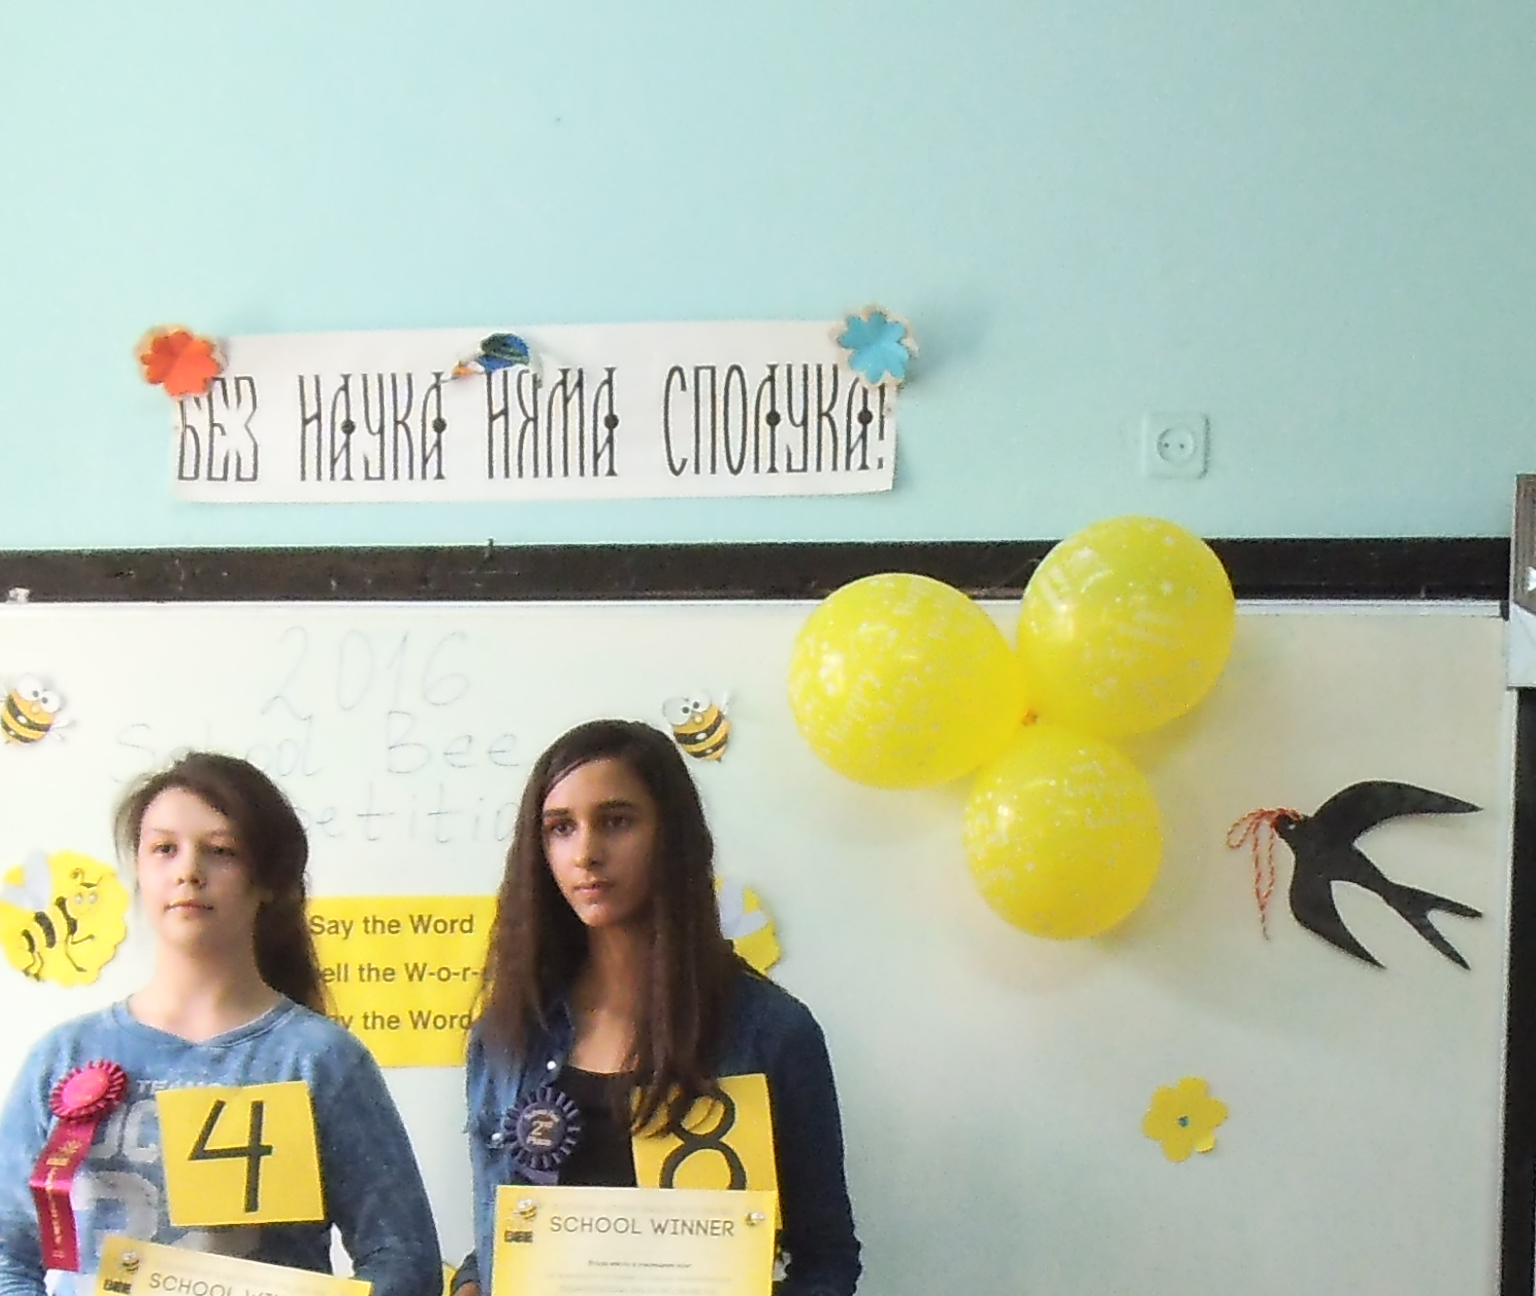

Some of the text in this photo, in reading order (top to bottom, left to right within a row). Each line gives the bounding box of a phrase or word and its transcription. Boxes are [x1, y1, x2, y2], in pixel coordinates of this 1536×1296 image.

[176, 362, 887, 483] БЕЗ НАУКА НЯМА СПОЛУКА!
[261, 626, 470, 720] 2016
[110, 710, 522, 784] Sool Bee
[296, 782, 517, 845] etitio
[309, 913, 475, 940] Say the Word
[322, 962, 483, 983] ell the W-o-r-
[363, 1011, 401, 1031] the
[408, 1010, 473, 1031] Word
[186, 1099, 274, 1214] 4
[658, 1086, 748, 1190] 8
[549, 1215, 736, 1237] SCHOOL WINNER
